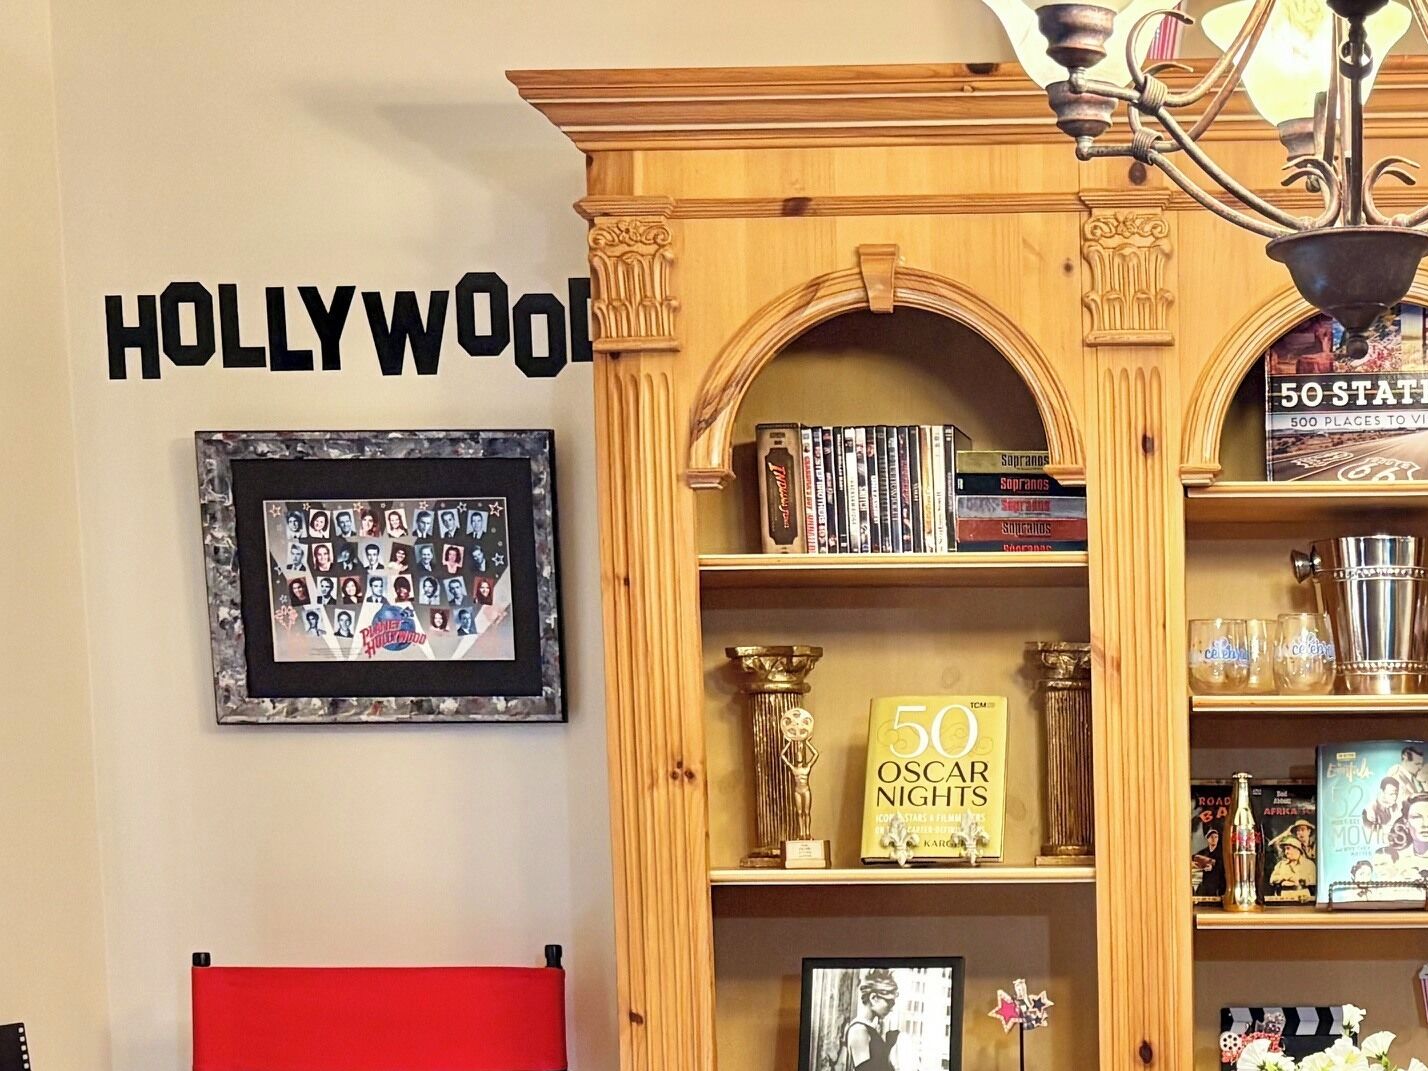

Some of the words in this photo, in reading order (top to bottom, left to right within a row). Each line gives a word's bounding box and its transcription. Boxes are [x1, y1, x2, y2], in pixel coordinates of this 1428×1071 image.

[1281, 381, 1324, 408] 50
[1290, 416, 1318, 428] 500
[1324, 415, 1381, 427] PLACES
[1388, 414, 1406, 426] TO
[1001, 454, 1049, 468] Sopranos
[1000, 477, 1050, 492] Sopranos
[1002, 522, 1051, 537] Sopranos
[889, 703, 979, 760] 50
[877, 760, 991, 784] OSCAR
[876, 785, 989, 808] NIGHTS
[1199, 796, 1232, 806] ROAD
[1263, 807, 1298, 816] AFRICA
